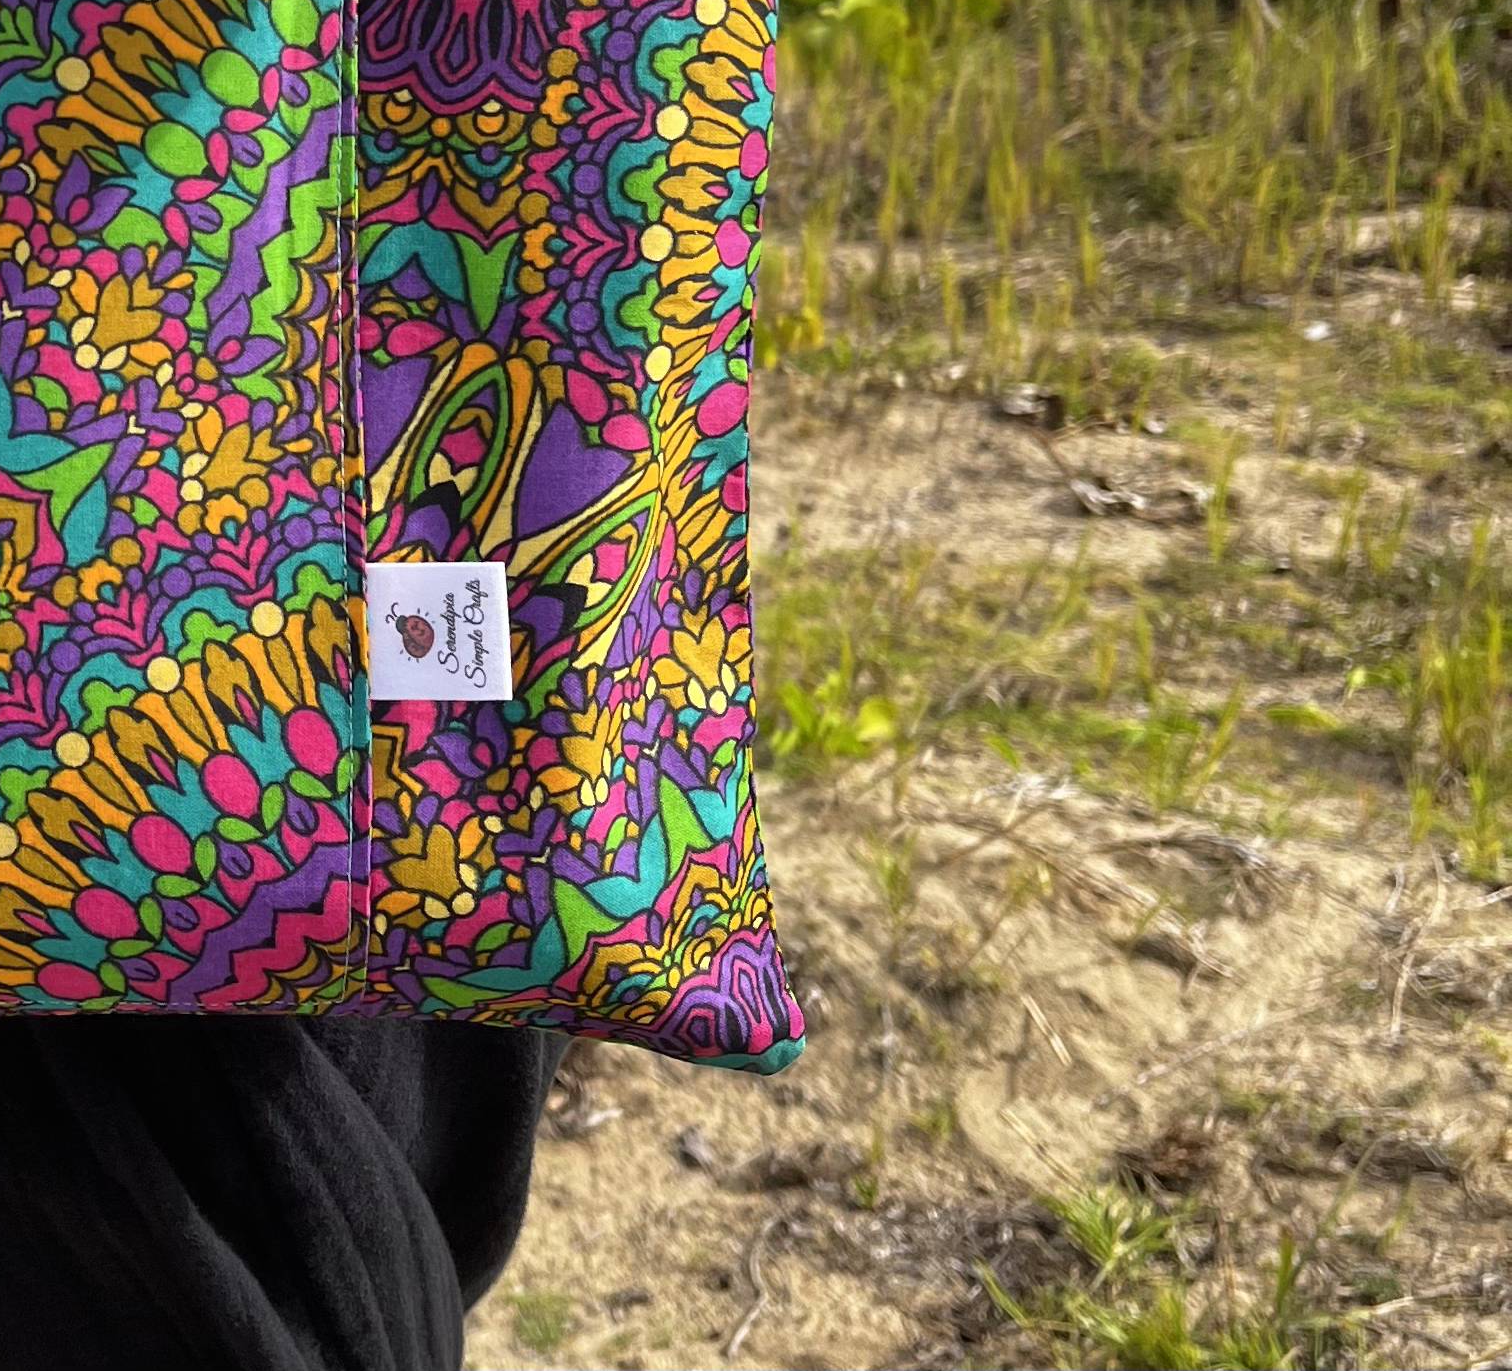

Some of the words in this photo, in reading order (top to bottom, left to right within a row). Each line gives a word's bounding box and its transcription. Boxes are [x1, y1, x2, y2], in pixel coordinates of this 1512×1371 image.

[463, 578, 489, 625] Crafts
[437, 592, 462, 674] Serendipia
[464, 629, 489, 688] Simple
